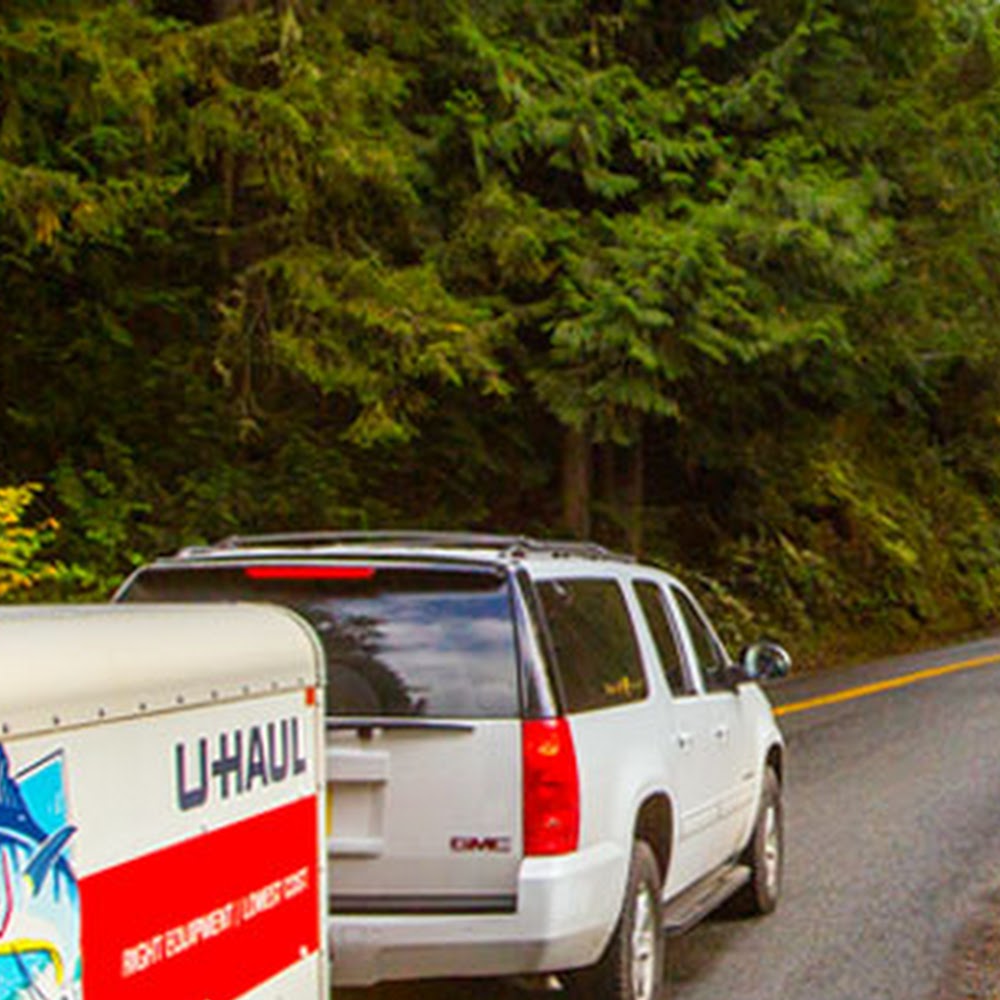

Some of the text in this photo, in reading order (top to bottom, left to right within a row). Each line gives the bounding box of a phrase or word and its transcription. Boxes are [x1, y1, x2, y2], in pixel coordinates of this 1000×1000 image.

[175, 716, 307, 812] U-HAUL
[450, 836, 511, 853] GMC
[121, 934, 164, 978] RIGHT
[165, 902, 234, 958] EQUIPMENT
